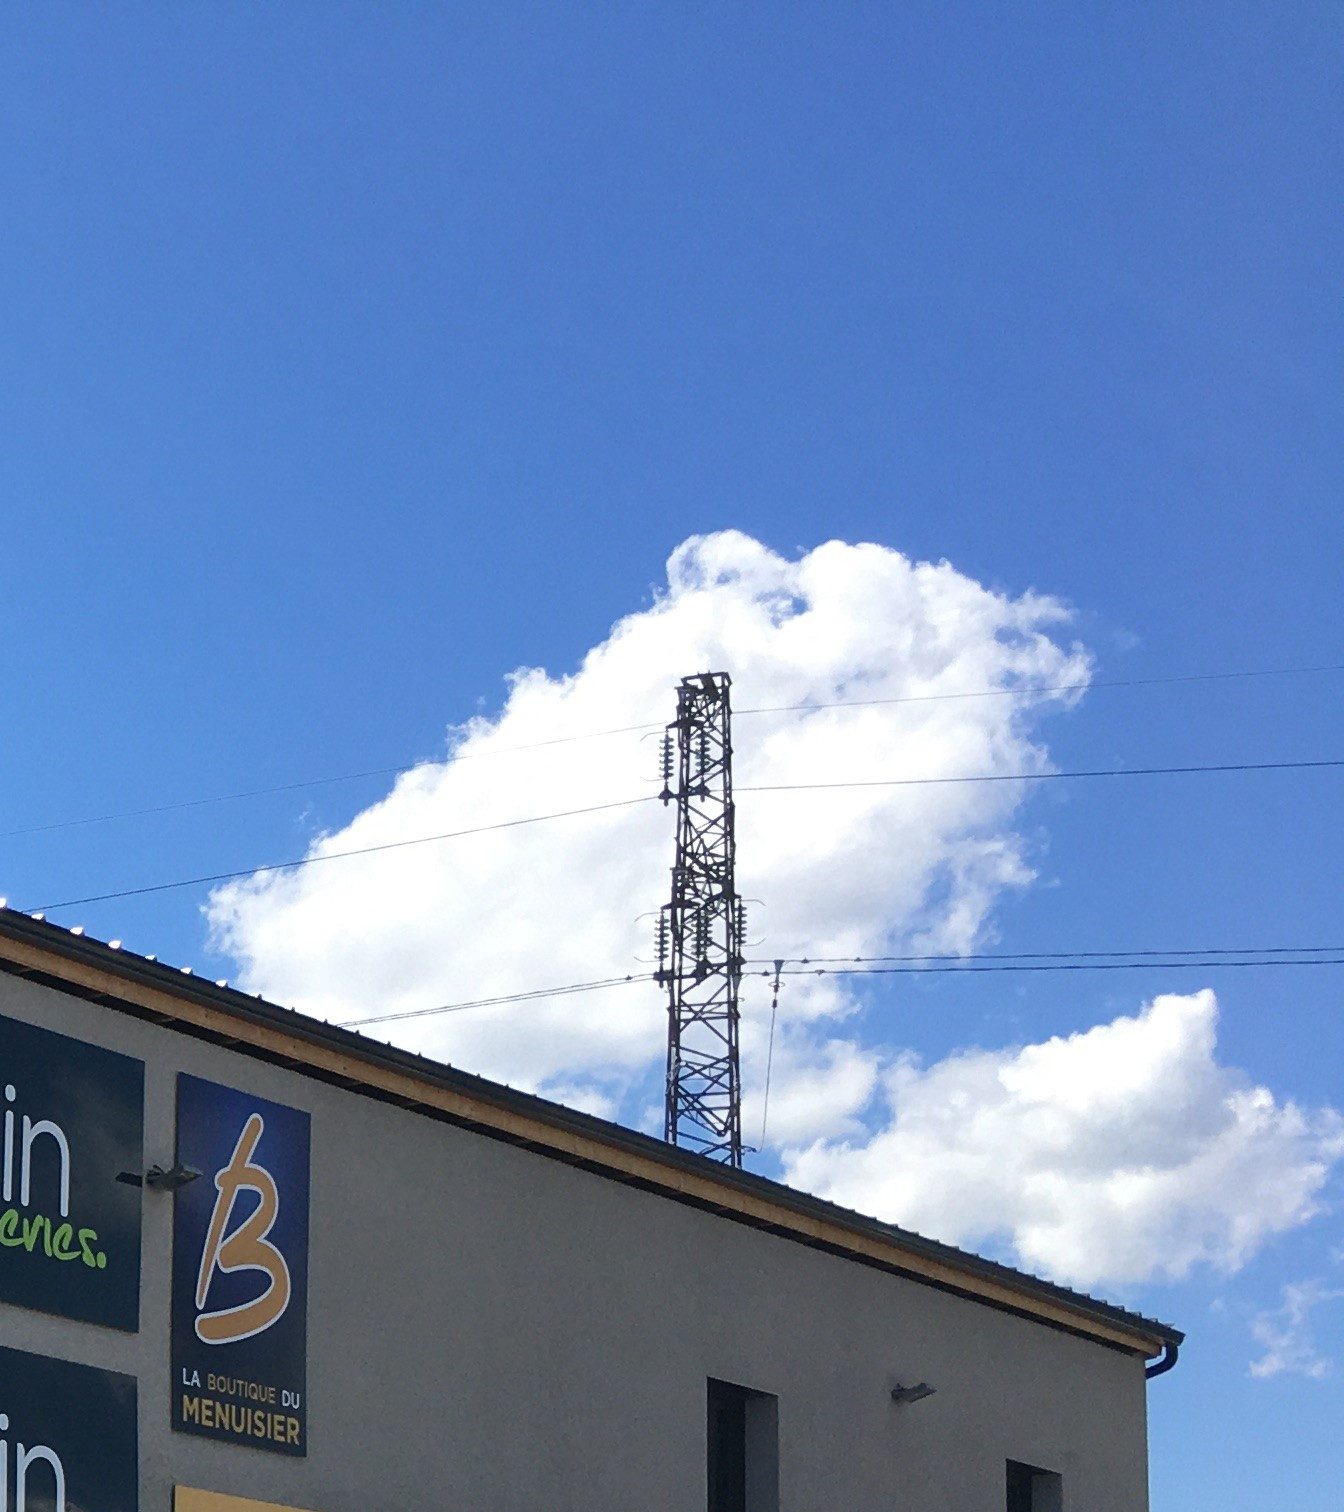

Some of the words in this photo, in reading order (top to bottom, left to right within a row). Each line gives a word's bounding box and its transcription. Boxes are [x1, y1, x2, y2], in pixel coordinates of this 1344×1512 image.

[182, 1367, 201, 1388] LA
[207, 1373, 276, 1404] BOUTIQUE
[281, 1389, 300, 1409] DU
[182, 1394, 300, 1446] MENUISIER
